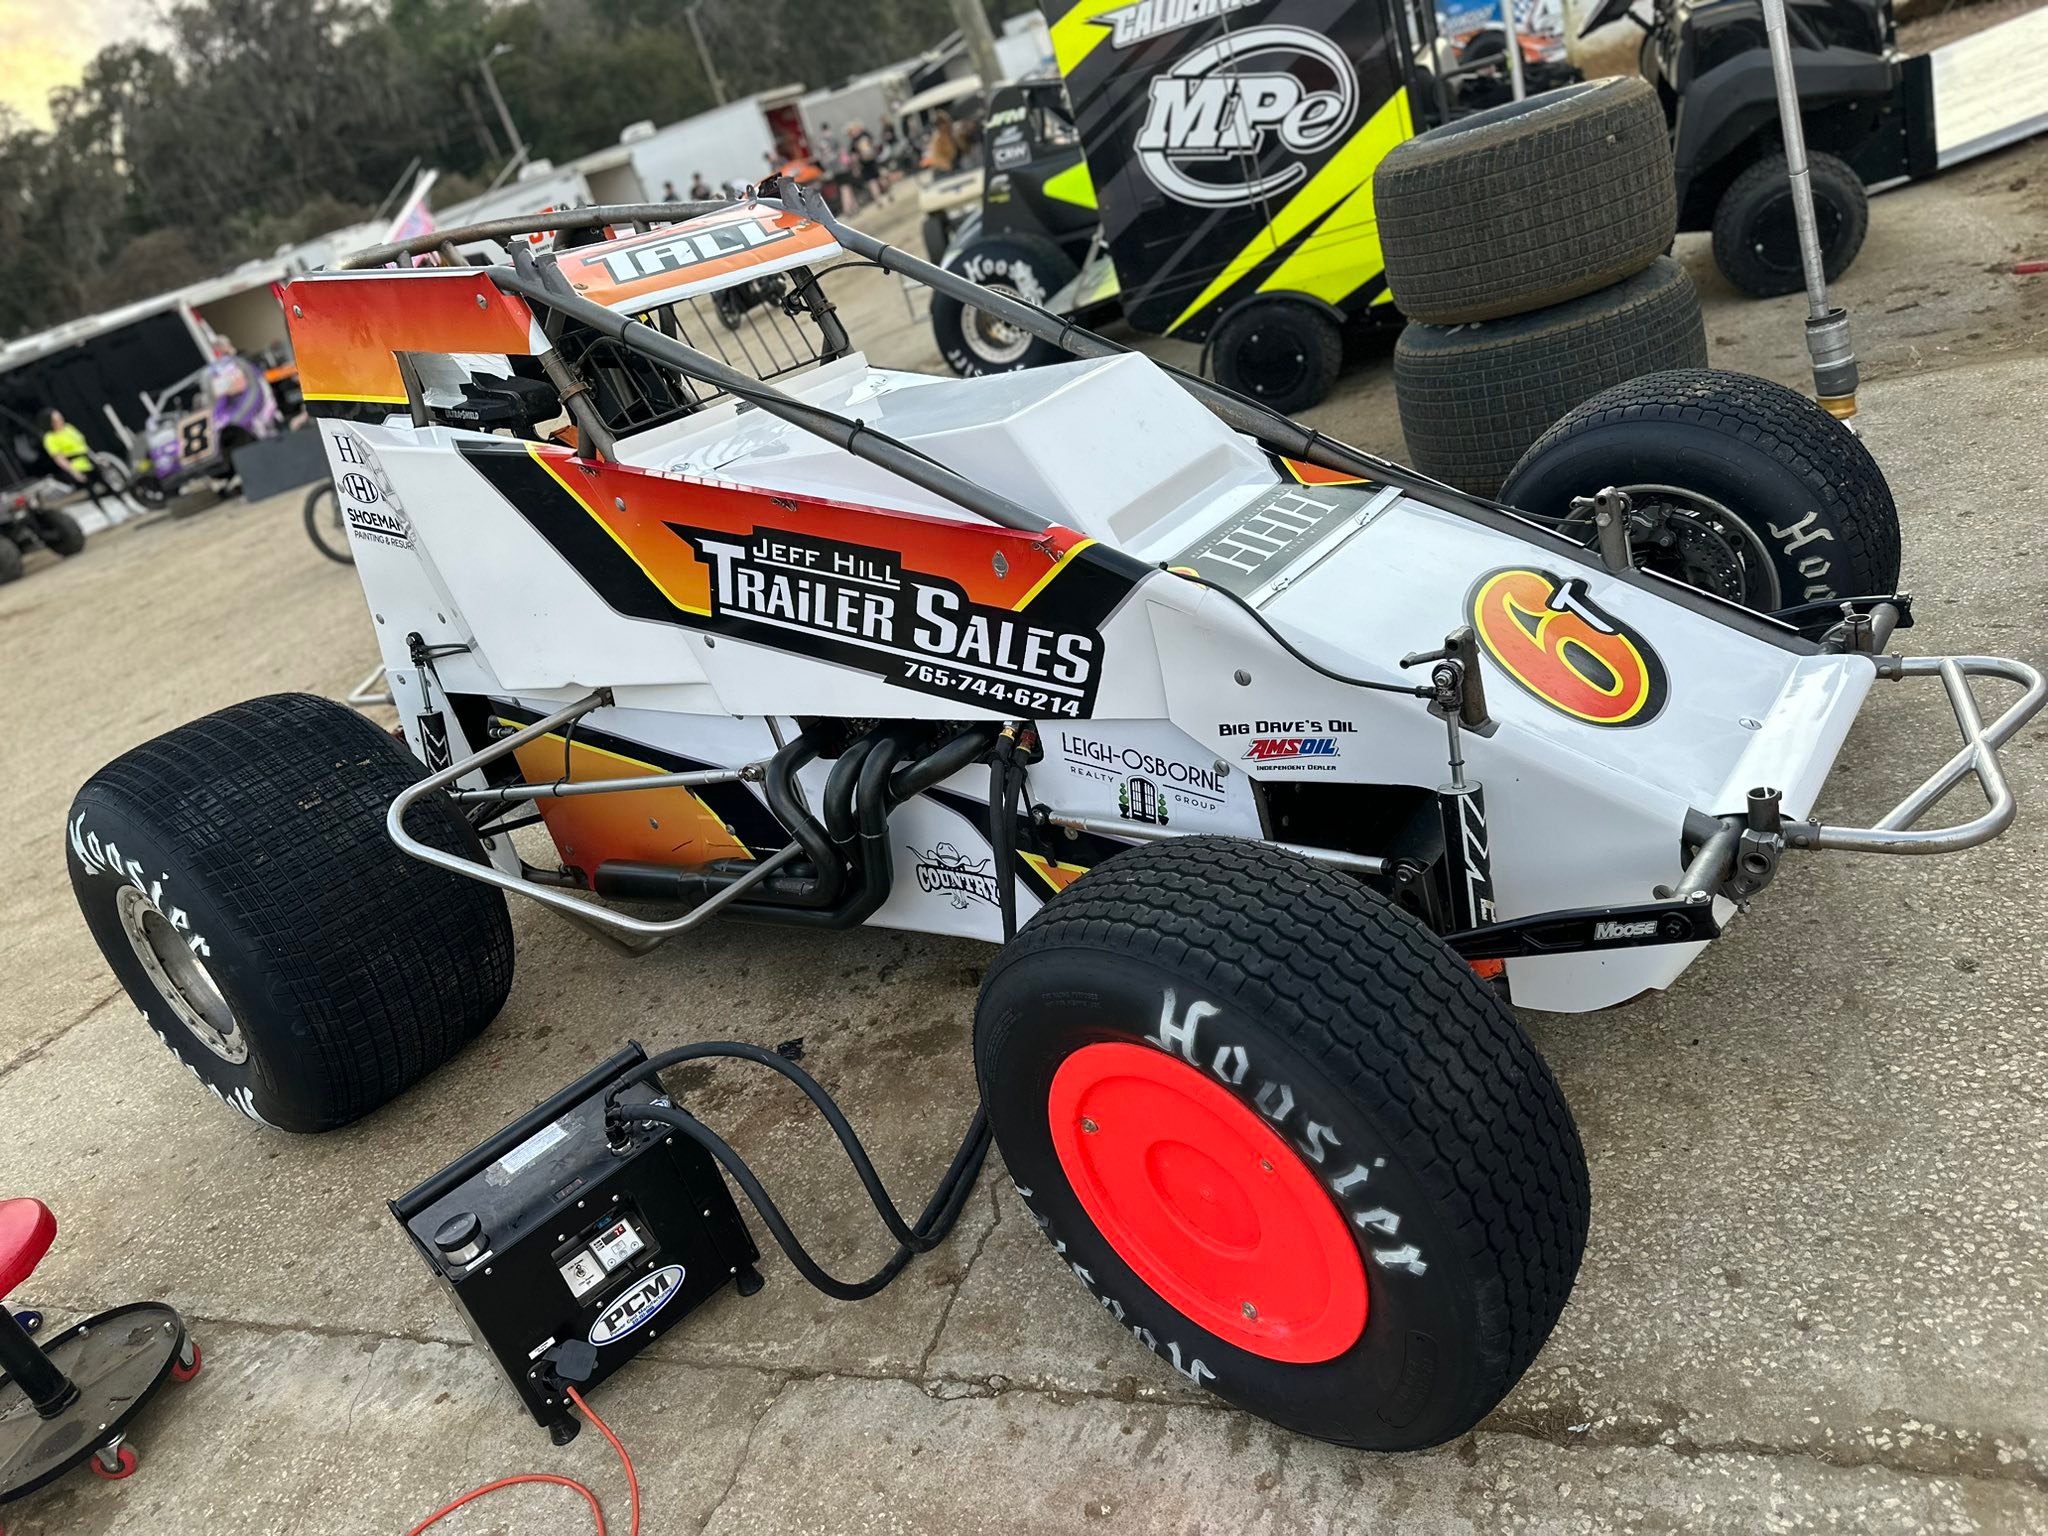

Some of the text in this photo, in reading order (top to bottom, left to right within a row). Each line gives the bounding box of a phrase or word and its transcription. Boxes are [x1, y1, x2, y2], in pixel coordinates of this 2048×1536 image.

[583, 218, 794, 284] TALL
[184, 418, 208, 458] 8
[354, 530, 385, 545] PAINTING
[385, 536, 391, 546] &
[1197, 490, 1339, 575] HHH
[752, 538, 900, 583] JEFF HILL
[910, 582, 1093, 684] SALES
[1219, 719, 1358, 737] BIG DAVE'S OIL
[1243, 738, 1338, 761] AMSOIL
[1061, 731, 1226, 794] LEIGH-OSBORNE
[1070, 765, 1115, 783] REALTY
[1174, 794, 1217, 811] GROUP
[69, 807, 211, 957] Hoosier
[916, 865, 1001, 908] COUNTRY
[1144, 986, 1428, 1277] Hoosier
[600, 1273, 670, 1333] PCM
